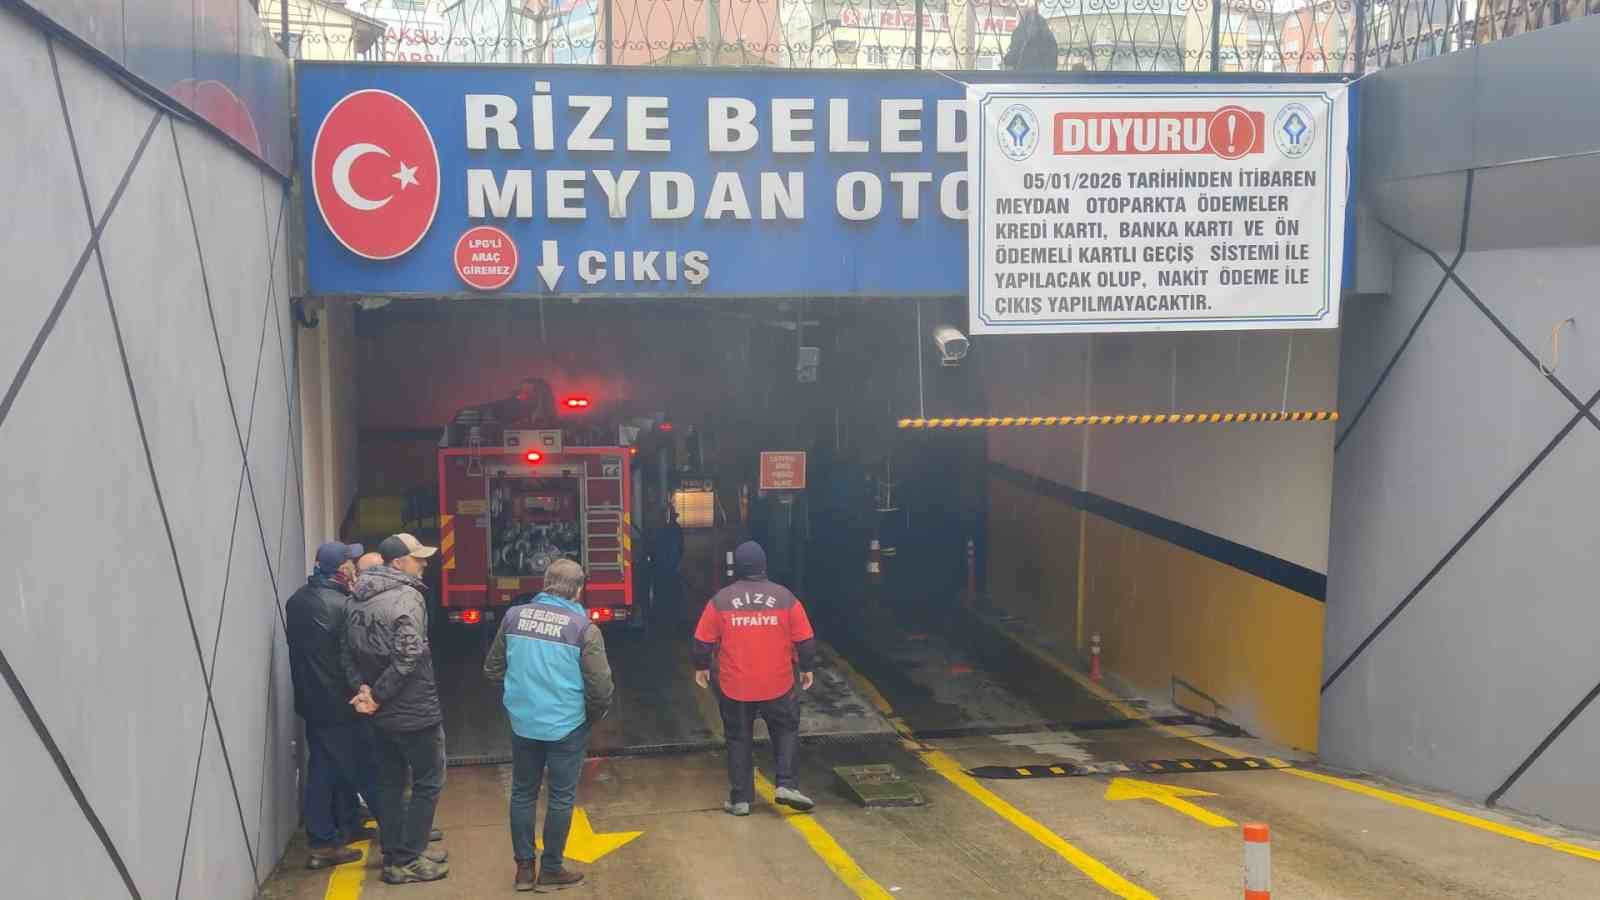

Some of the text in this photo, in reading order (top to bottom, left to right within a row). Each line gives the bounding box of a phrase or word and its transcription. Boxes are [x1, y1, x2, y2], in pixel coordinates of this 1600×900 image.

[385, 26, 438, 45] AKSU
[465, 80, 672, 152] RİZE
[1062, 117, 1207, 152] DUYURU
[1023, 168, 1316, 191] 05/01/2026 TARİHİNDEN İTİBAREN
[466, 168, 805, 220] MEYDAN
[996, 192, 1288, 214] MEYDAN OTOPARKTA ÖDEMELER
[995, 216, 1299, 240] KREDİ KARTI, BANKA KARTI VE ÖN
[471, 252, 501, 264] ARAÇ
[995, 241, 1309, 264] ÖDEMELİ KARTLI GEÇİŞ SİSTEMİ İLE
[463, 265, 510, 275] GİREMEZ
[578, 250, 710, 285] ÇIKIŞ
[995, 272, 1091, 289] YAPILACAK
[1158, 267, 1208, 287] NAKİT
[1220, 266, 1279, 285] ÖDEME
[1285, 265, 1309, 284] İLE
[995, 294, 1212, 315] ÇIKIŞ YAPILMAYACAKTIR.
